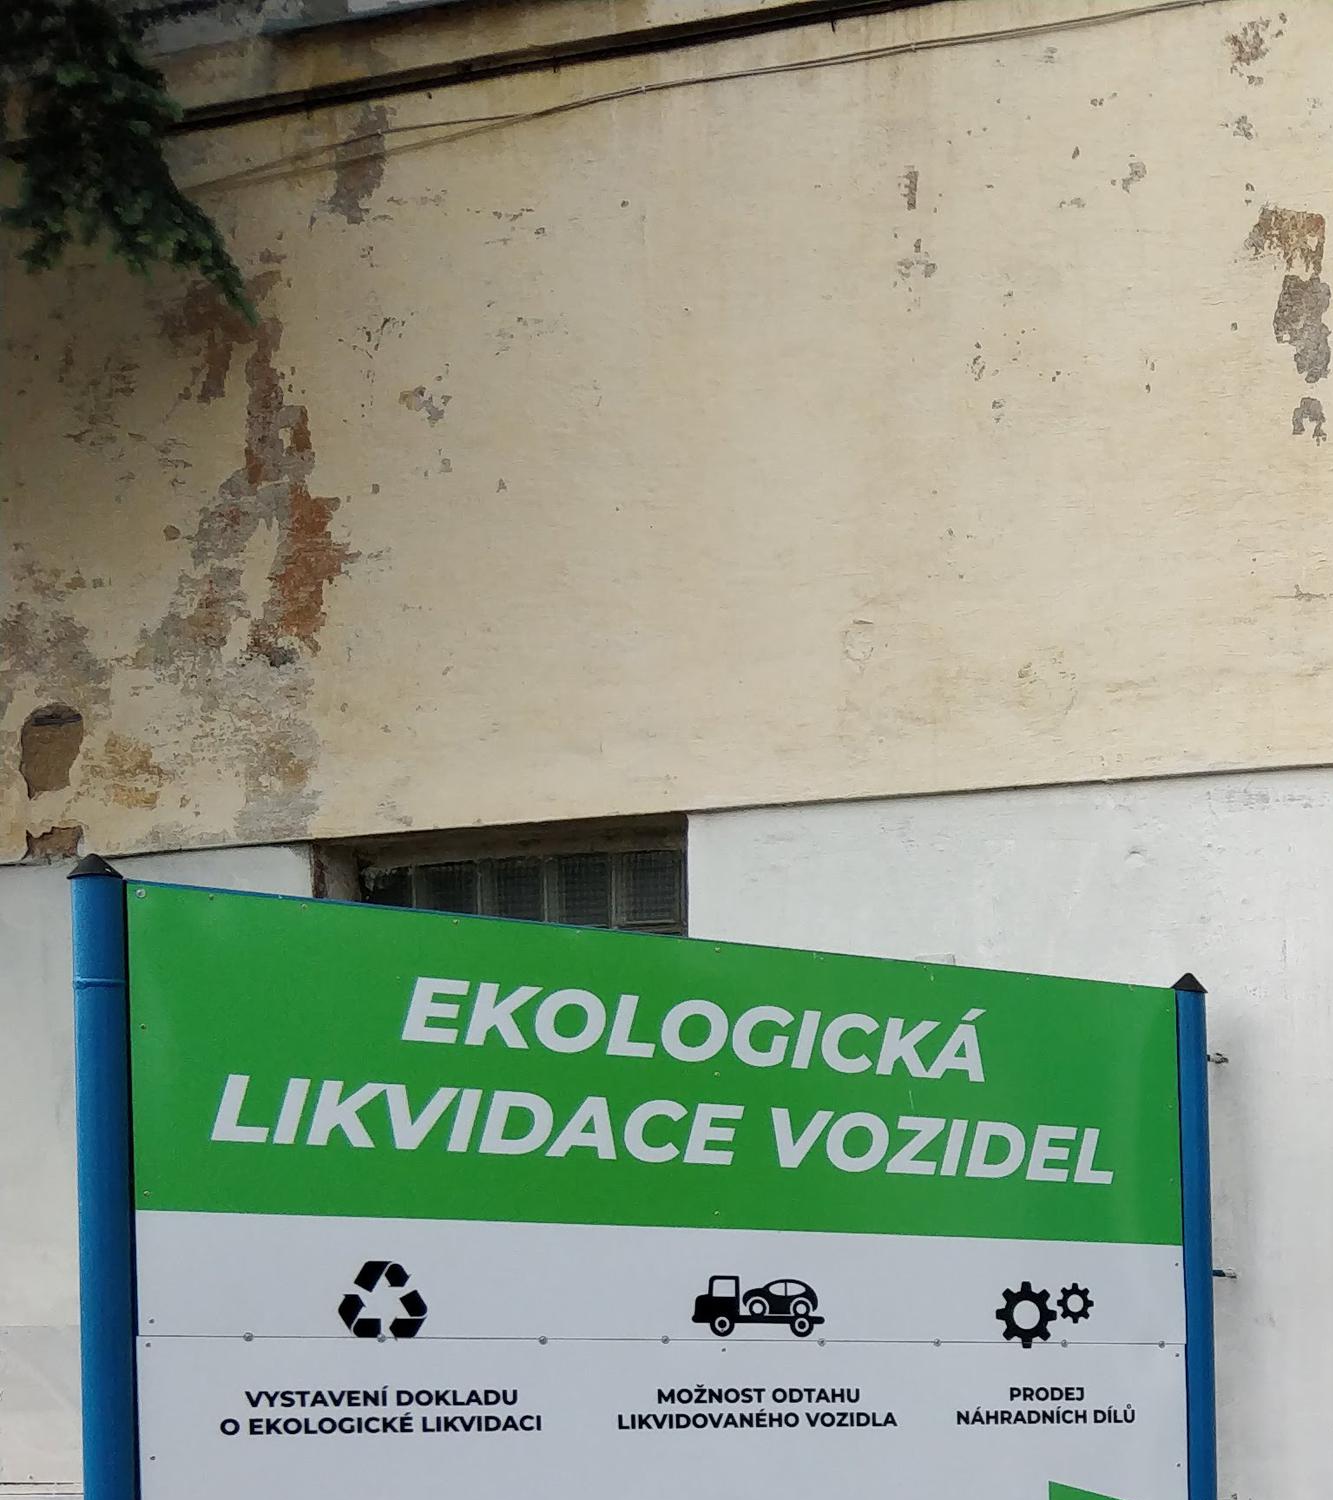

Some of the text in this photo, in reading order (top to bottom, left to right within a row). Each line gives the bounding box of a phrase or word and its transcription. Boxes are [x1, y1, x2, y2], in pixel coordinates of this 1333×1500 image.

[401, 976, 987, 1083] EKOLOGICKÁ
[210, 1073, 1115, 1185] LIKVIDACE VOZIDEL
[244, 1385, 518, 1408] VYSTAVENÍ DOKLADU
[657, 1383, 860, 1405] MOŽNOST ODTAHU
[1009, 1386, 1085, 1402] PRODEJ
[219, 1411, 542, 1436] O EKOLOGICKÉ LIKVIDACI
[617, 1407, 898, 1430] LIKVIDOVANÉHO VOZIDLA
[956, 1403, 1136, 1426] NÁHRADNÍCH DÍLŮ
